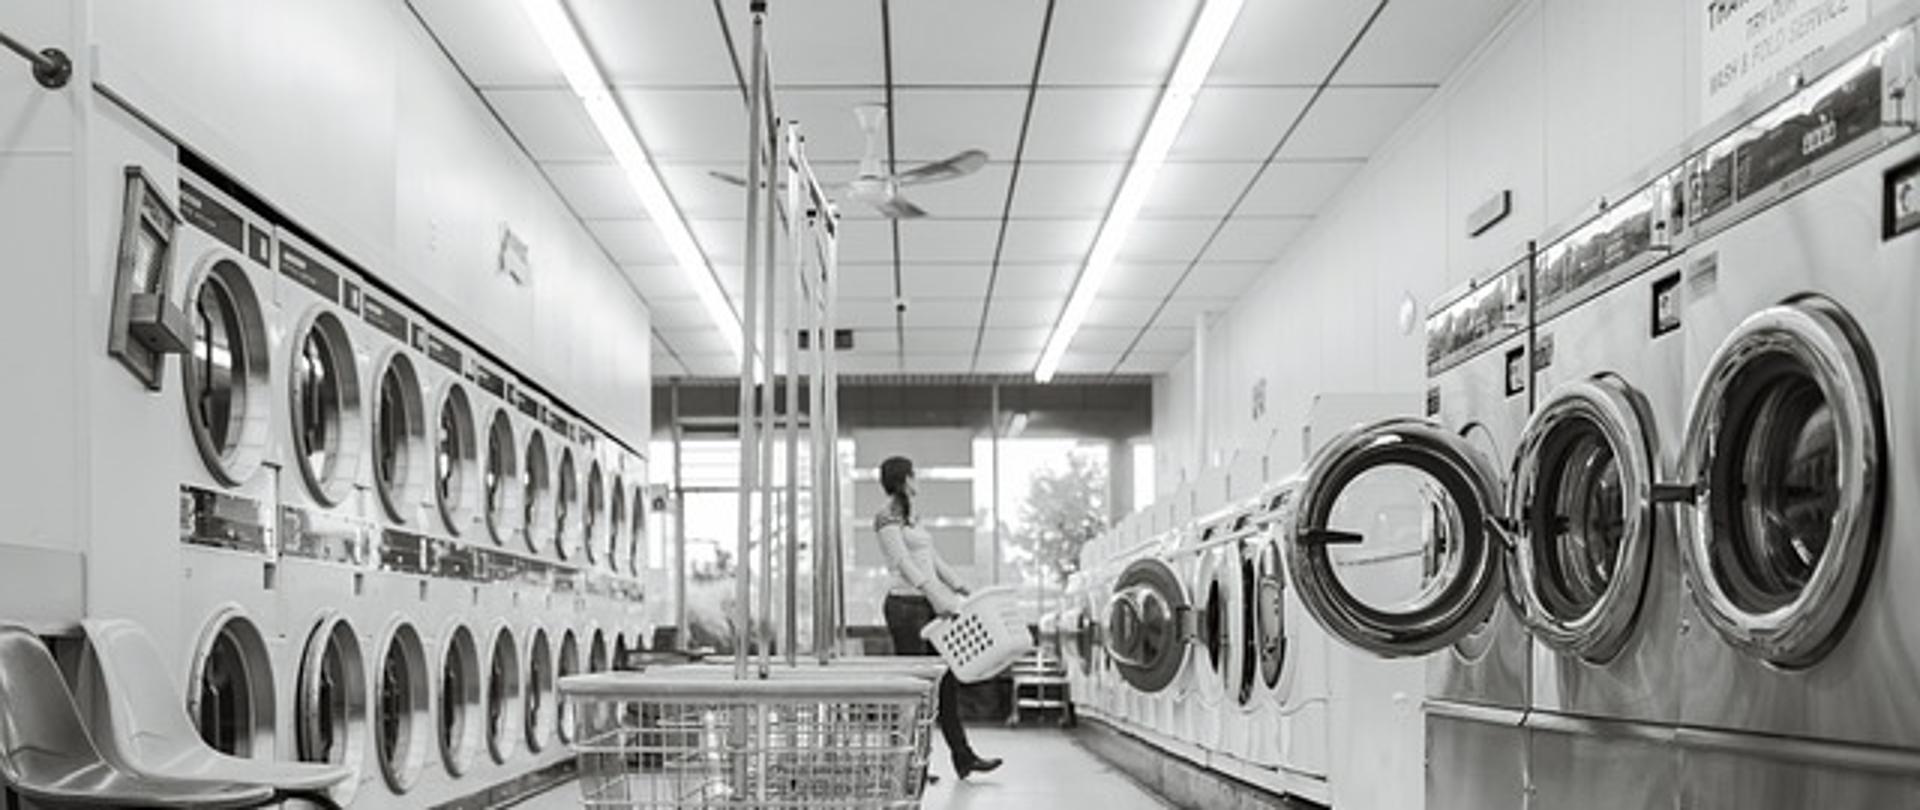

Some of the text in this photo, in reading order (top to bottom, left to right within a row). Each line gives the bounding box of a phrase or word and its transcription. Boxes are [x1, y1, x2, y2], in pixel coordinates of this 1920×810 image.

[1709, 60, 1739, 96] WASH
[1752, 26, 1786, 69] FOLD
[1788, 0, 1850, 45] SERVICE
[1746, 9, 1768, 42] TRY
